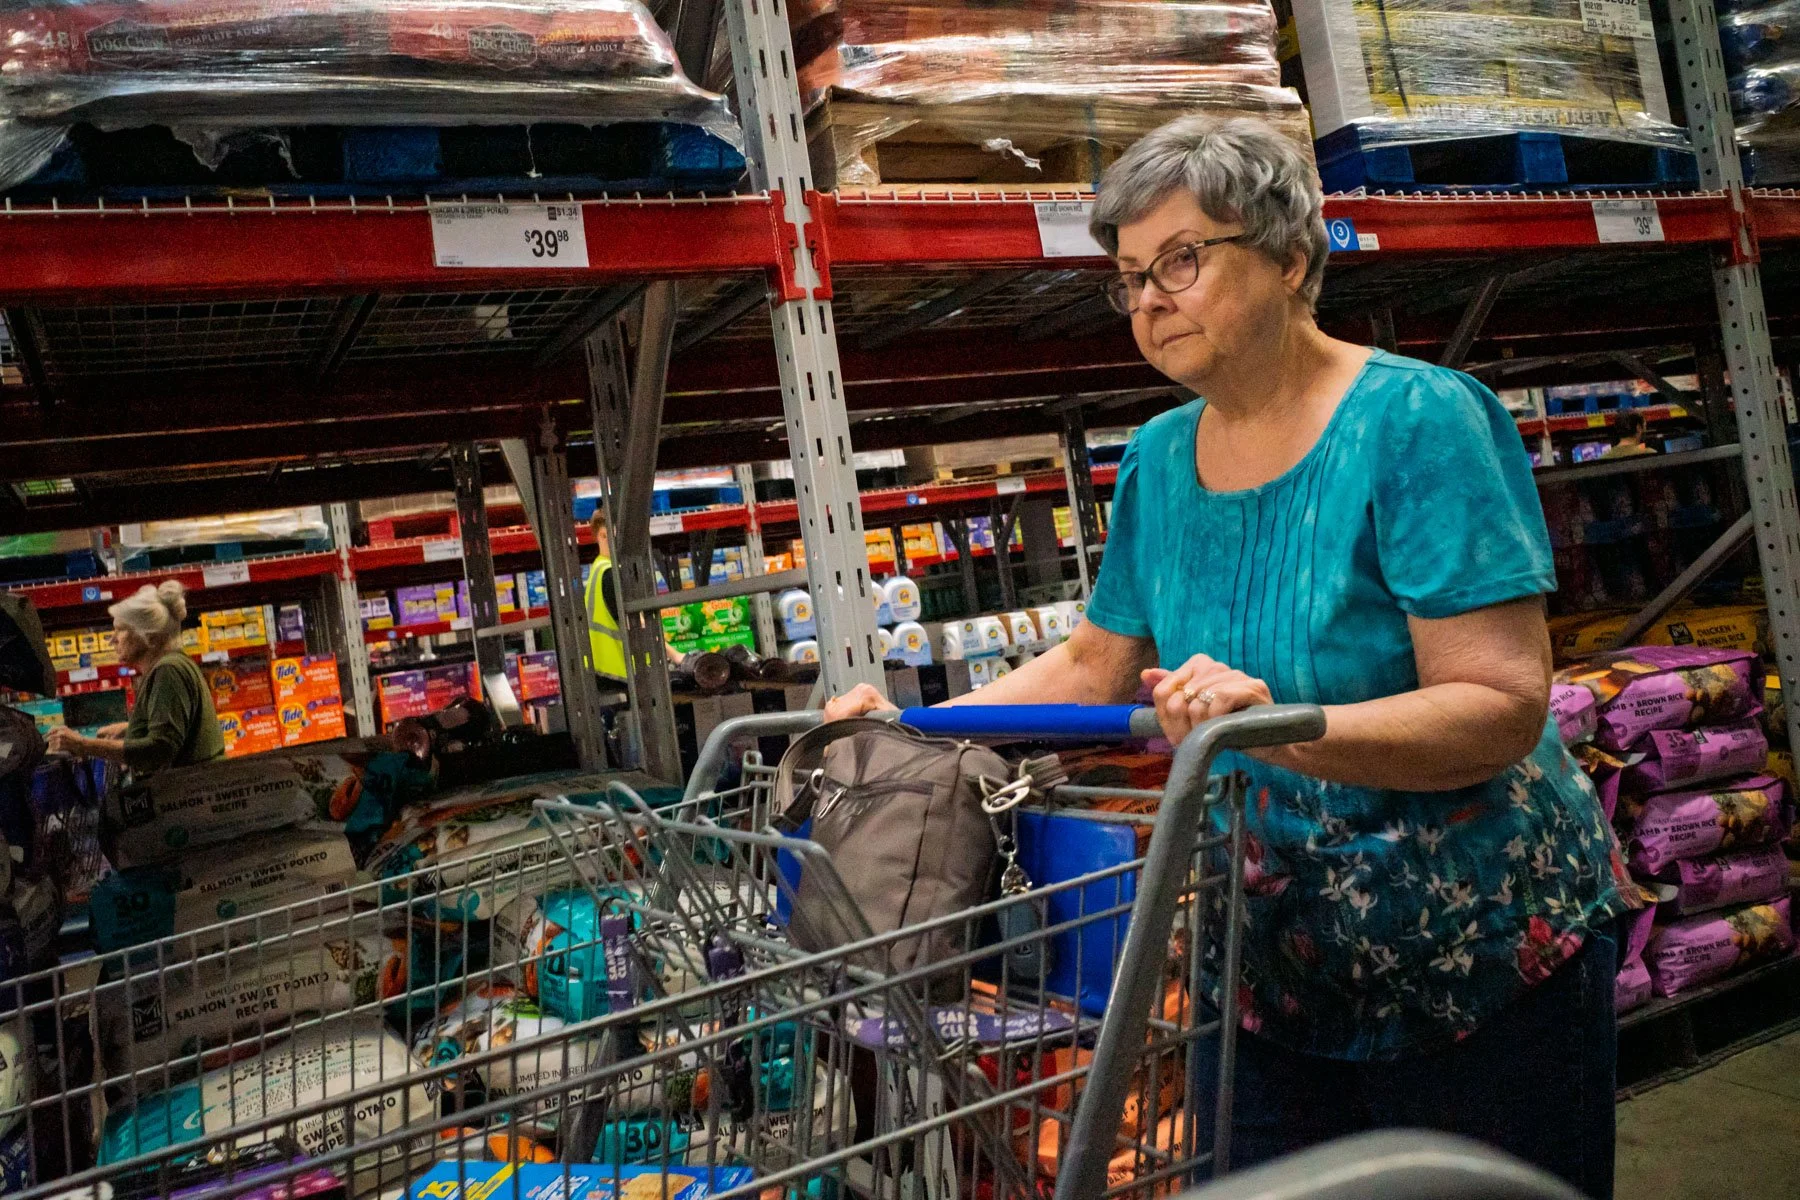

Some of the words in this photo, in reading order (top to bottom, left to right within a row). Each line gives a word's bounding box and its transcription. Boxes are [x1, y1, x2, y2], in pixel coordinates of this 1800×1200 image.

[556, 207, 578, 217] $1.34
[1336, 226, 1345, 237] 3
[276, 665, 297, 680] Tide
[1637, 696, 1666, 708] BROWN
[1667, 692, 1684, 702] RICE
[282, 708, 303, 725] Tide
[1634, 706, 1663, 717] RECIPE
[1665, 732, 1686, 748] 35
[215, 790, 252, 803] SWEET
[254, 779, 294, 794] POTATO
[211, 799, 248, 814] RECIPE
[1671, 822, 1700, 833] BROWN
[1701, 818, 1716, 827] RICE
[1669, 831, 1697, 842] RECIPE
[200, 876, 242, 894] SALMON
[254, 863, 287, 879] SWEET
[289, 851, 328, 868] POTATO
[250, 872, 286, 889] RECIPE
[1685, 943, 1715, 955] BROWN
[1716, 938, 1731, 948] RICE
[236, 998, 278, 1019] RECPE
[303, 1117, 346, 1146] SWEET
[354, 1096, 396, 1121] OTATO
[309, 1134, 346, 1158] ECIPE
[626, 1122, 662, 1154] 30
